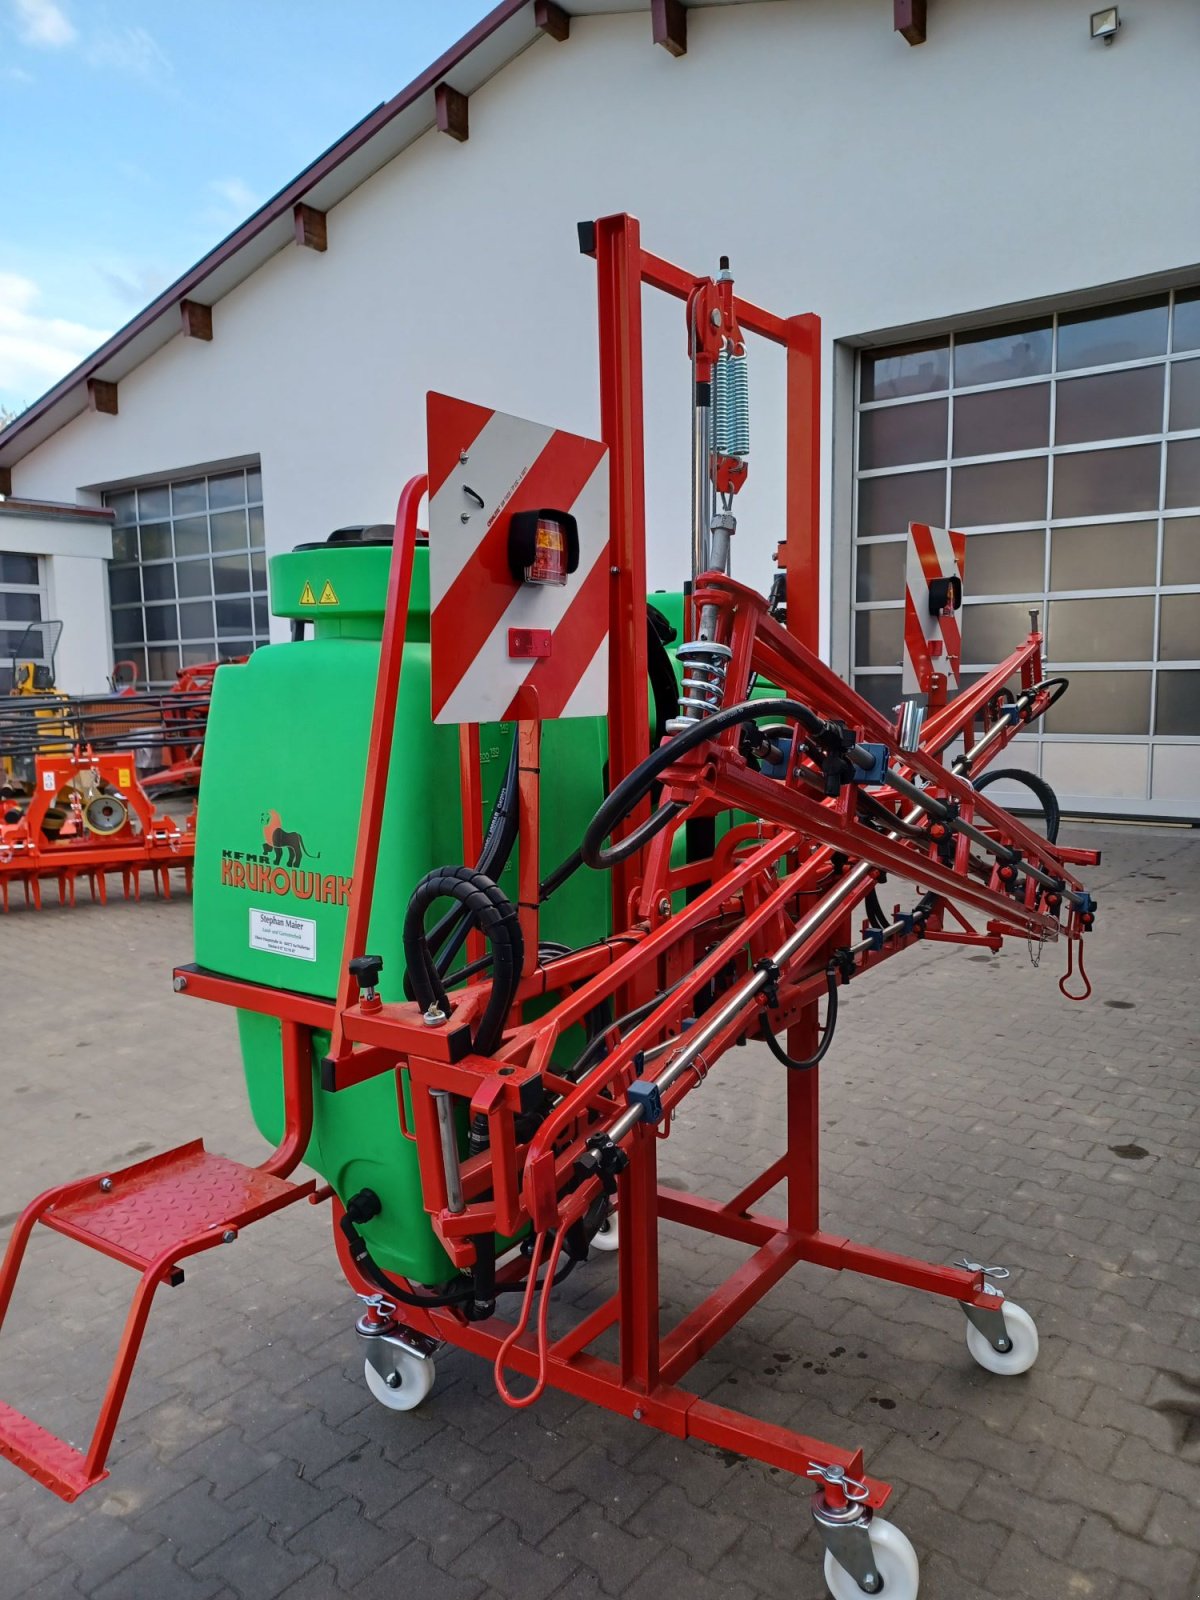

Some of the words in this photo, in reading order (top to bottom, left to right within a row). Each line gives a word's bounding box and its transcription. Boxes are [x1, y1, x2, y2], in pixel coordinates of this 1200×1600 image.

[222, 849, 270, 864] KFMR
[221, 857, 353, 905] KRUKOWIAK
[260, 913, 284, 926] Stephan
[285, 919, 304, 930] Maier
